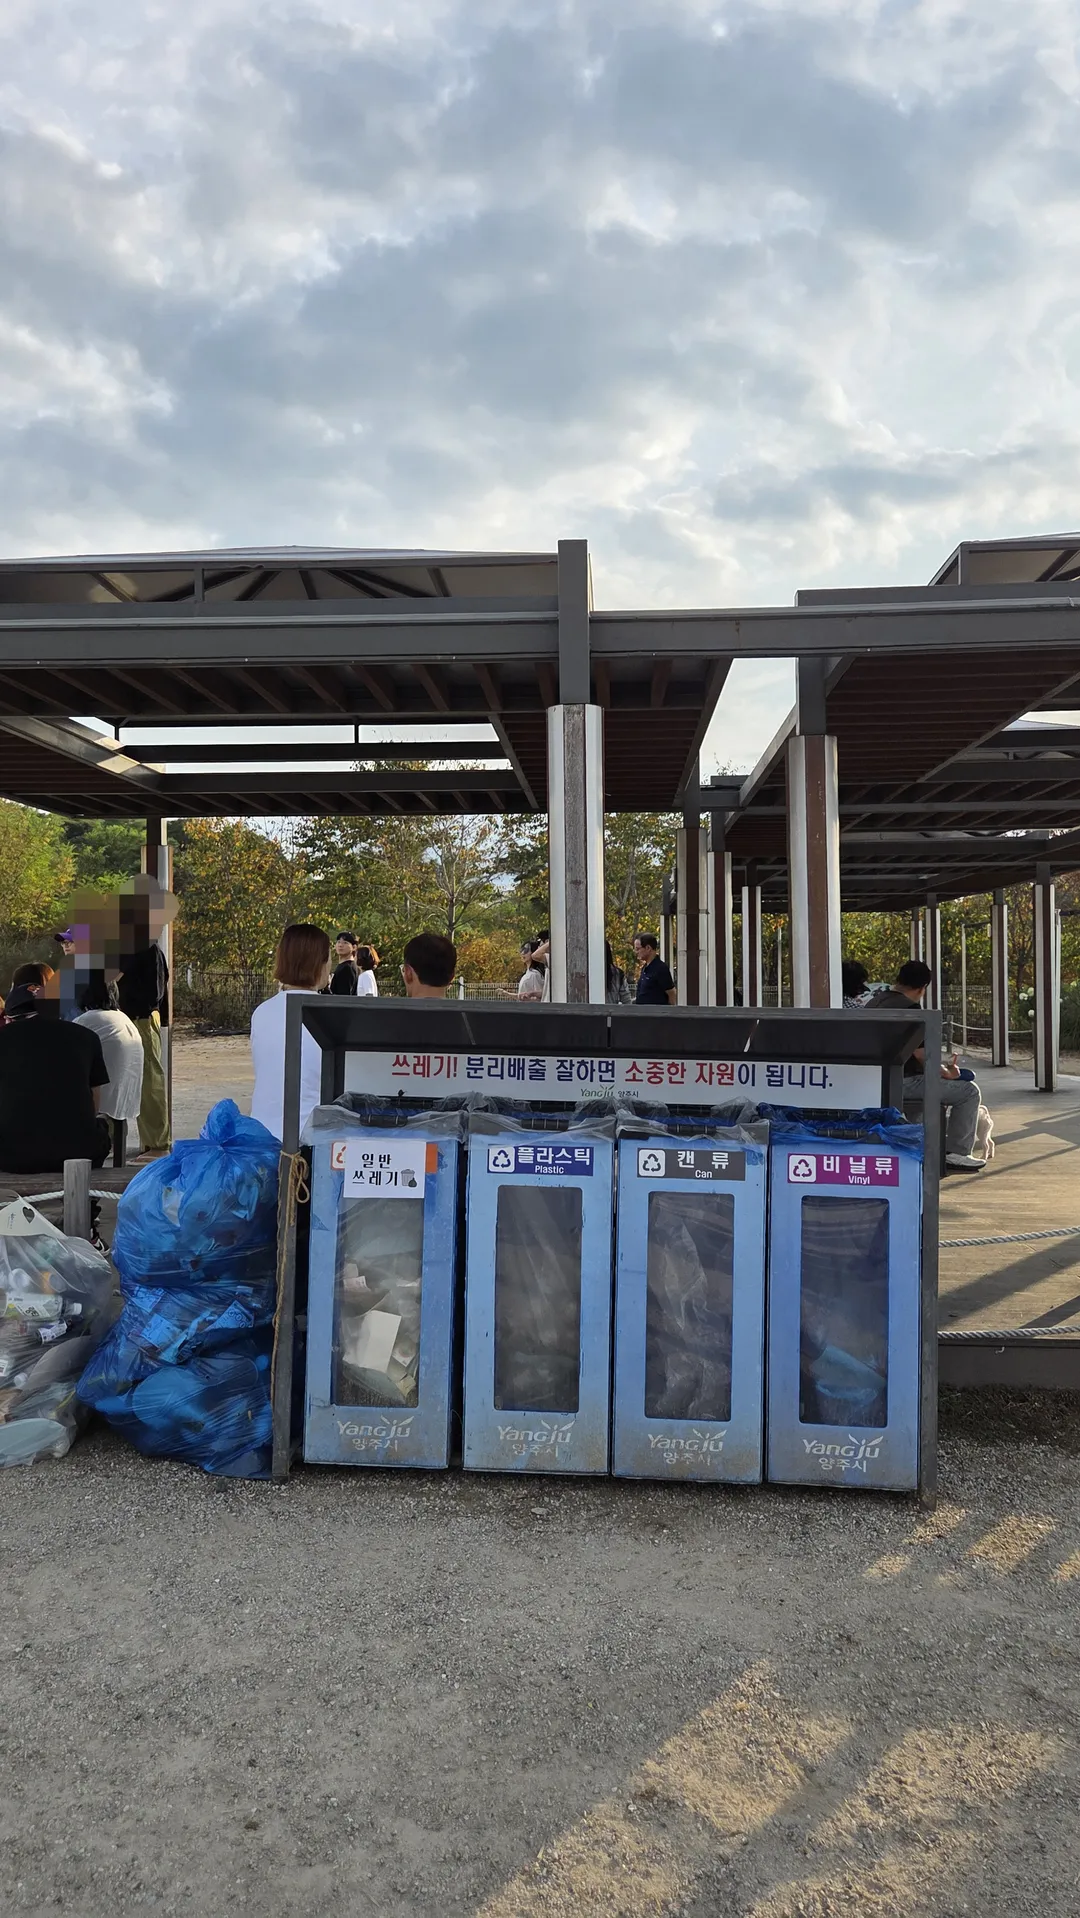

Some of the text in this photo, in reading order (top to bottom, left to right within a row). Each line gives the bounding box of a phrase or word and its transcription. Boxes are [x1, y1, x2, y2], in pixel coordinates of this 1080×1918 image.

[391, 1054, 834, 1090] 쓰레기! 분리배출 잘하면 소중한 자원이 됩니다.
[617, 1090, 639, 1099] 양주시
[361, 1153, 392, 1169] 일반
[516, 1146, 591, 1166] 플라스틱
[534, 1164, 565, 1175] Plastic
[694, 1168, 713, 1179] Can
[351, 1170, 399, 1187] 쓰레기
[847, 1174, 871, 1185] Vinyl
[351, 1438, 399, 1451] 양주시
[512, 1443, 559, 1458] 양주시
[663, 1452, 711, 1467] 양주시
[818, 1457, 868, 1473] 양주시
